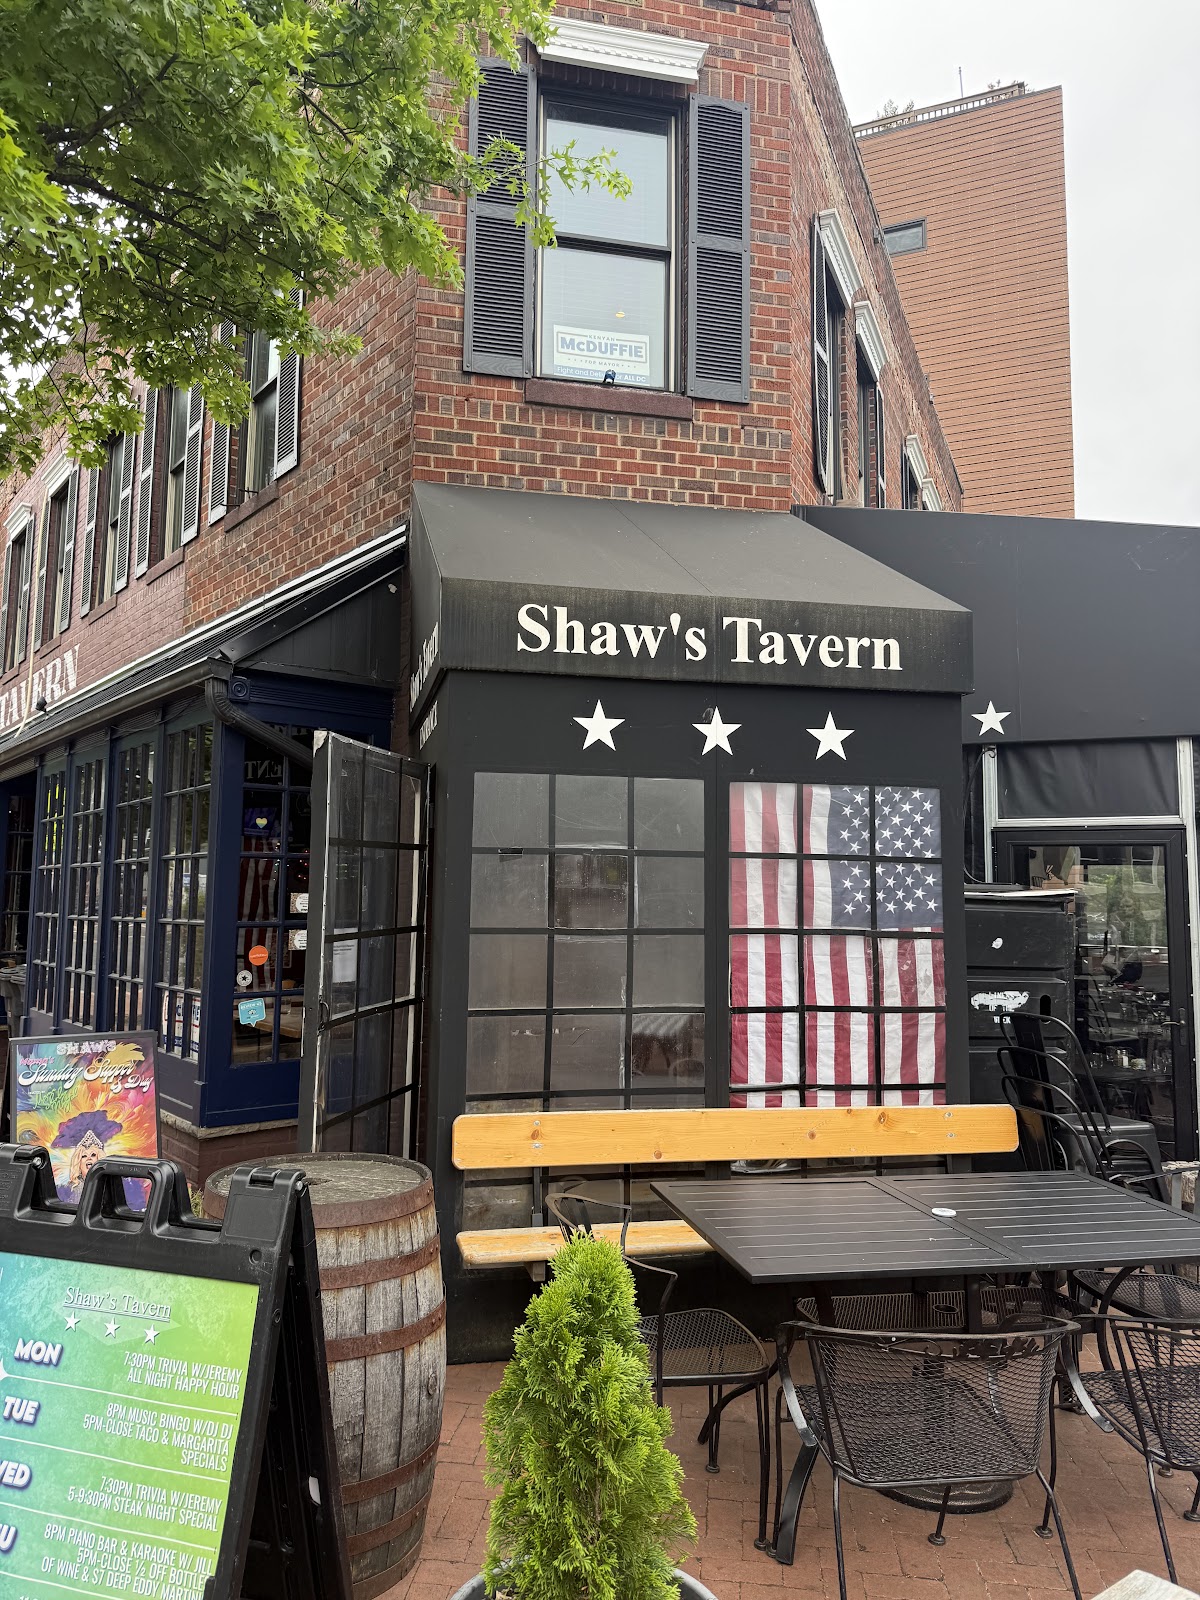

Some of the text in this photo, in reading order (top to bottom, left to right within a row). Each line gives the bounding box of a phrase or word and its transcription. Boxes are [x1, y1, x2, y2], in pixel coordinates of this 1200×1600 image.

[560, 336, 644, 359] McDUFFIE
[588, 334, 616, 342] KENYAN
[557, 366, 574, 376] Fight
[575, 369, 589, 377] and
[517, 603, 903, 672] Shaw's Tavern
[56, 1039, 117, 1056] SHAW'S
[18, 1062, 84, 1089] Sunday
[64, 1286, 172, 1318] Shaw's Tavern
[14, 1337, 63, 1366] MON
[123, 1351, 243, 1384] 7:30PM TRIVIA W/JEREMY
[127, 1367, 240, 1400] ALL NIGHT HAPPY HOUR
[2, 1395, 40, 1424] TUE
[106, 1402, 233, 1440] 8PM MUSIC BINGO W/DJ DJ
[83, 1413, 229, 1456] 5PM-CLOSE TACO & MARGARITA
[180, 1450, 227, 1472] SPECIALS
[67, 1486, 218, 1532] 5-9:30PM STEAK NIGHT SPECIAL
[100, 1476, 222, 1515] 7:30PM TRIVIA W/JEREMY
[44, 1523, 213, 1576] 8PM PIANO BAR & KARAOKE W/ JILL
[77, 1547, 133, 1574] 5PM-CLOSE
[148, 1562, 168, 1583] OFF
[41, 1556, 56, 1572] OF
[57, 1559, 80, 1579] WINE
[81, 1565, 89, 1582] &
[91, 1568, 105, 1586] $7
[105, 1572, 132, 1591] DEEP
[132, 1578, 163, 1598] EDDY
